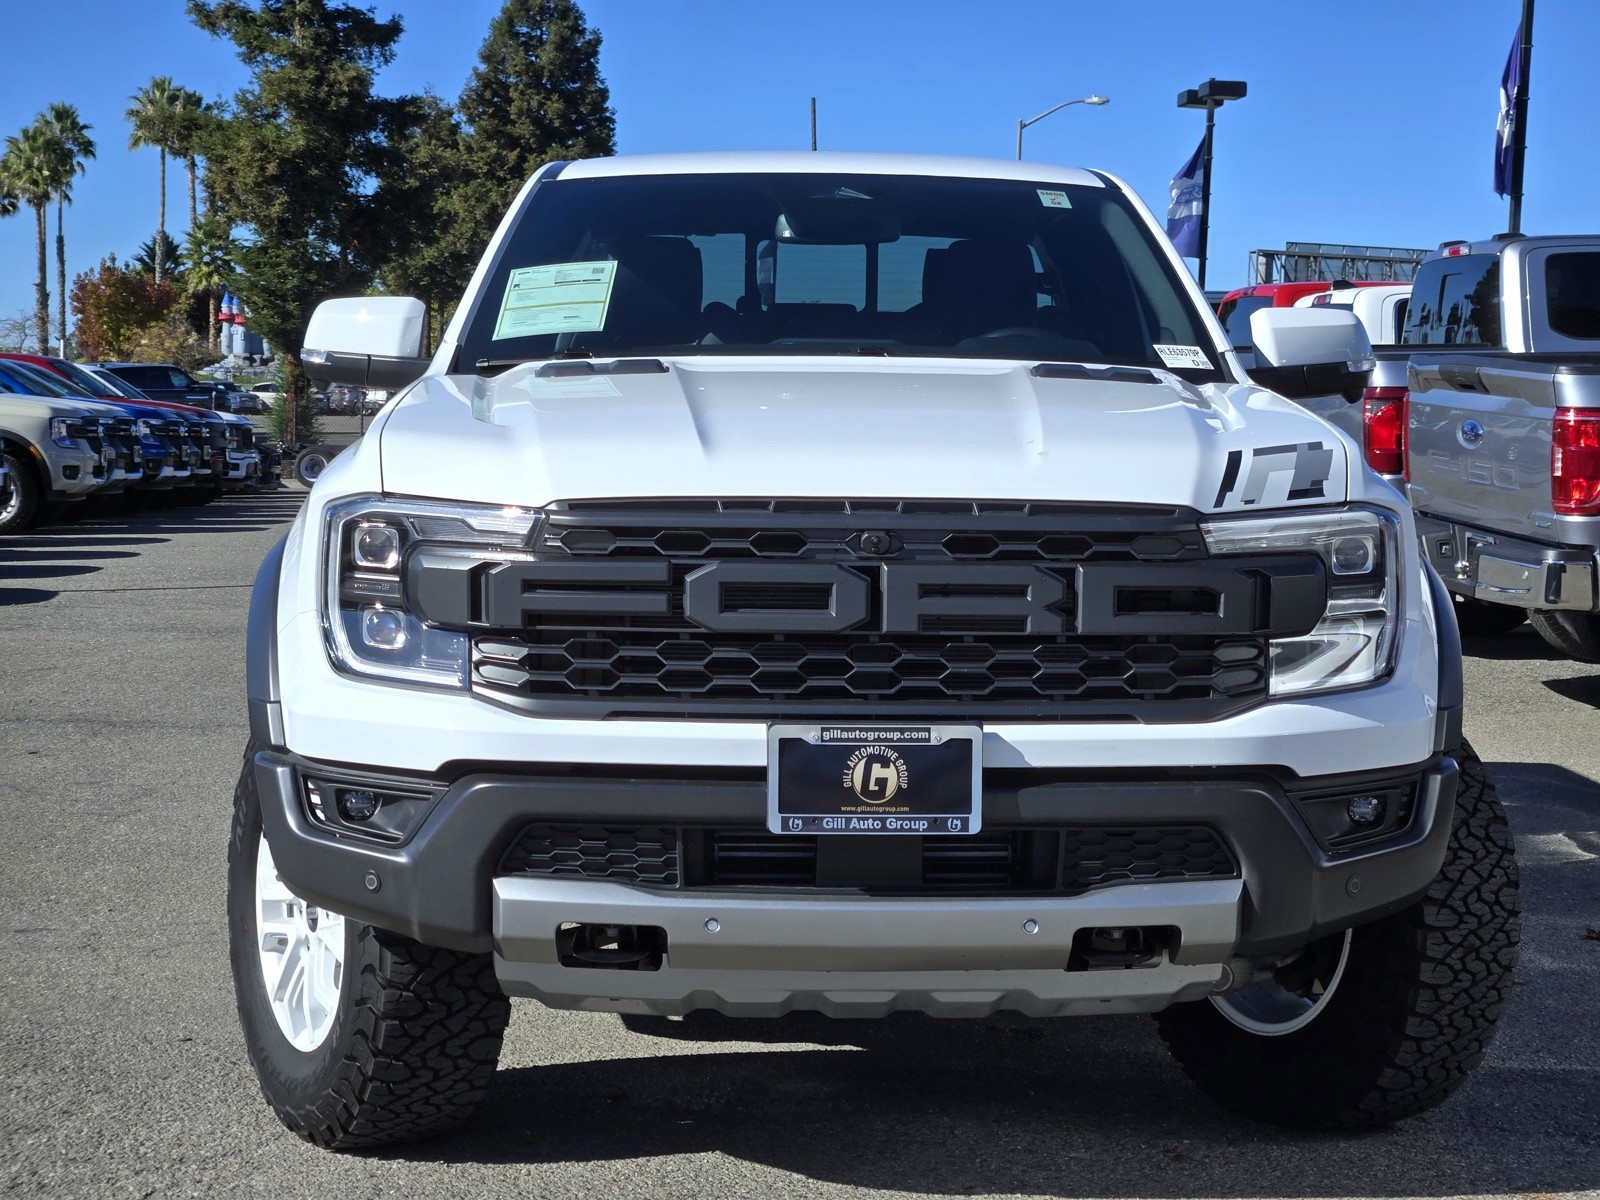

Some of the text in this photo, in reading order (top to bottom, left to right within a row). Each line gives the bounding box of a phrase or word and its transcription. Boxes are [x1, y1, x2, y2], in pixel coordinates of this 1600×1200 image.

[483, 560, 1256, 636] FORD
[822, 729, 929, 741] gillautogroup.com
[842, 745, 909, 789] GILL AUTOMOTIVE GROUP
[840, 805, 910, 813] www.gillautogroup.com
[822, 817, 929, 832] Gill Auto Group
